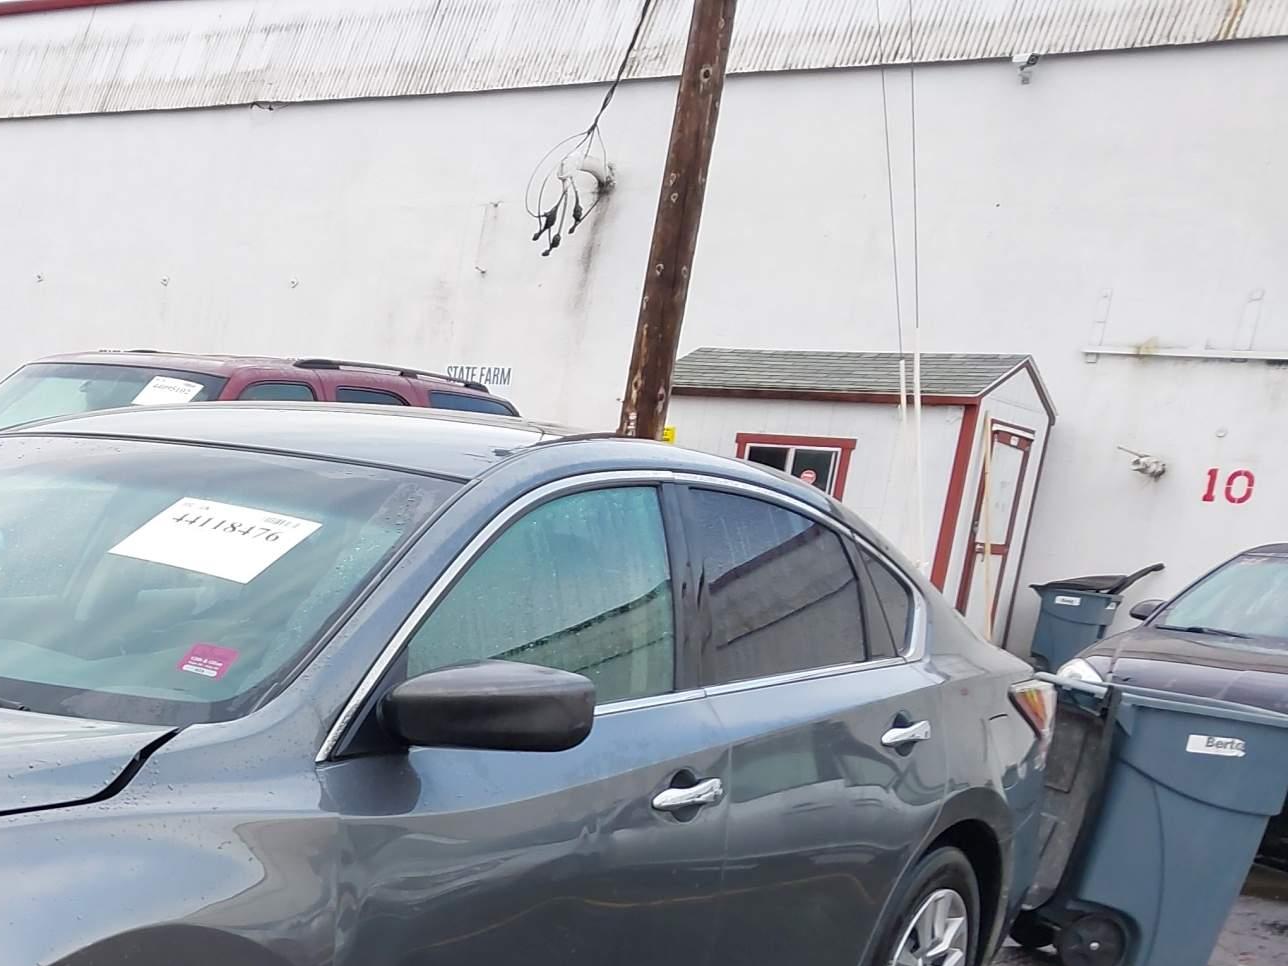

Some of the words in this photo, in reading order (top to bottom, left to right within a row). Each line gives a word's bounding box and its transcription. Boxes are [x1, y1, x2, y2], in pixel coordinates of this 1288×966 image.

[447, 365, 478, 383] STATE
[479, 366, 512, 385] FARM
[1201, 468, 1255, 504] 10
[172, 513, 284, 543] 44118476
